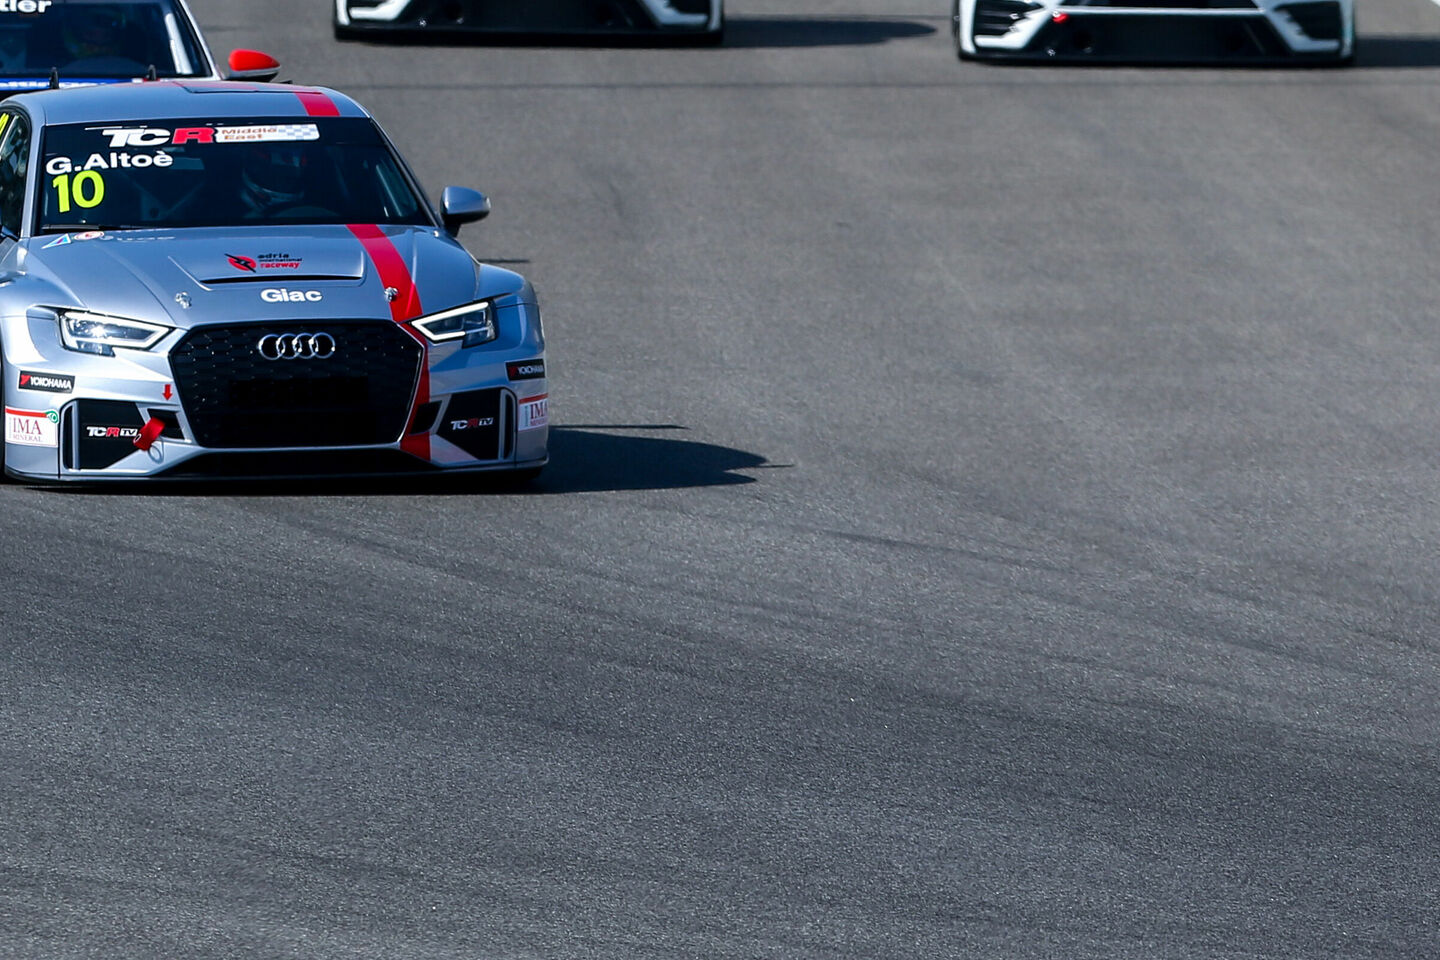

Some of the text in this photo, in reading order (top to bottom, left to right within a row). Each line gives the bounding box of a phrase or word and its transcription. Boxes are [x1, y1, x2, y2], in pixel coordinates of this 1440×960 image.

[102, 127, 215, 147] TCR
[46, 150, 173, 175] G.Altoè
[52, 170, 105, 213] 10
[260, 288, 322, 302] Giac
[30, 376, 72, 389] YOKOHAMA
[13, 419, 42, 435] IMA
[87, 426, 138, 437] TCR TV
[451, 418, 479, 430] TCR
